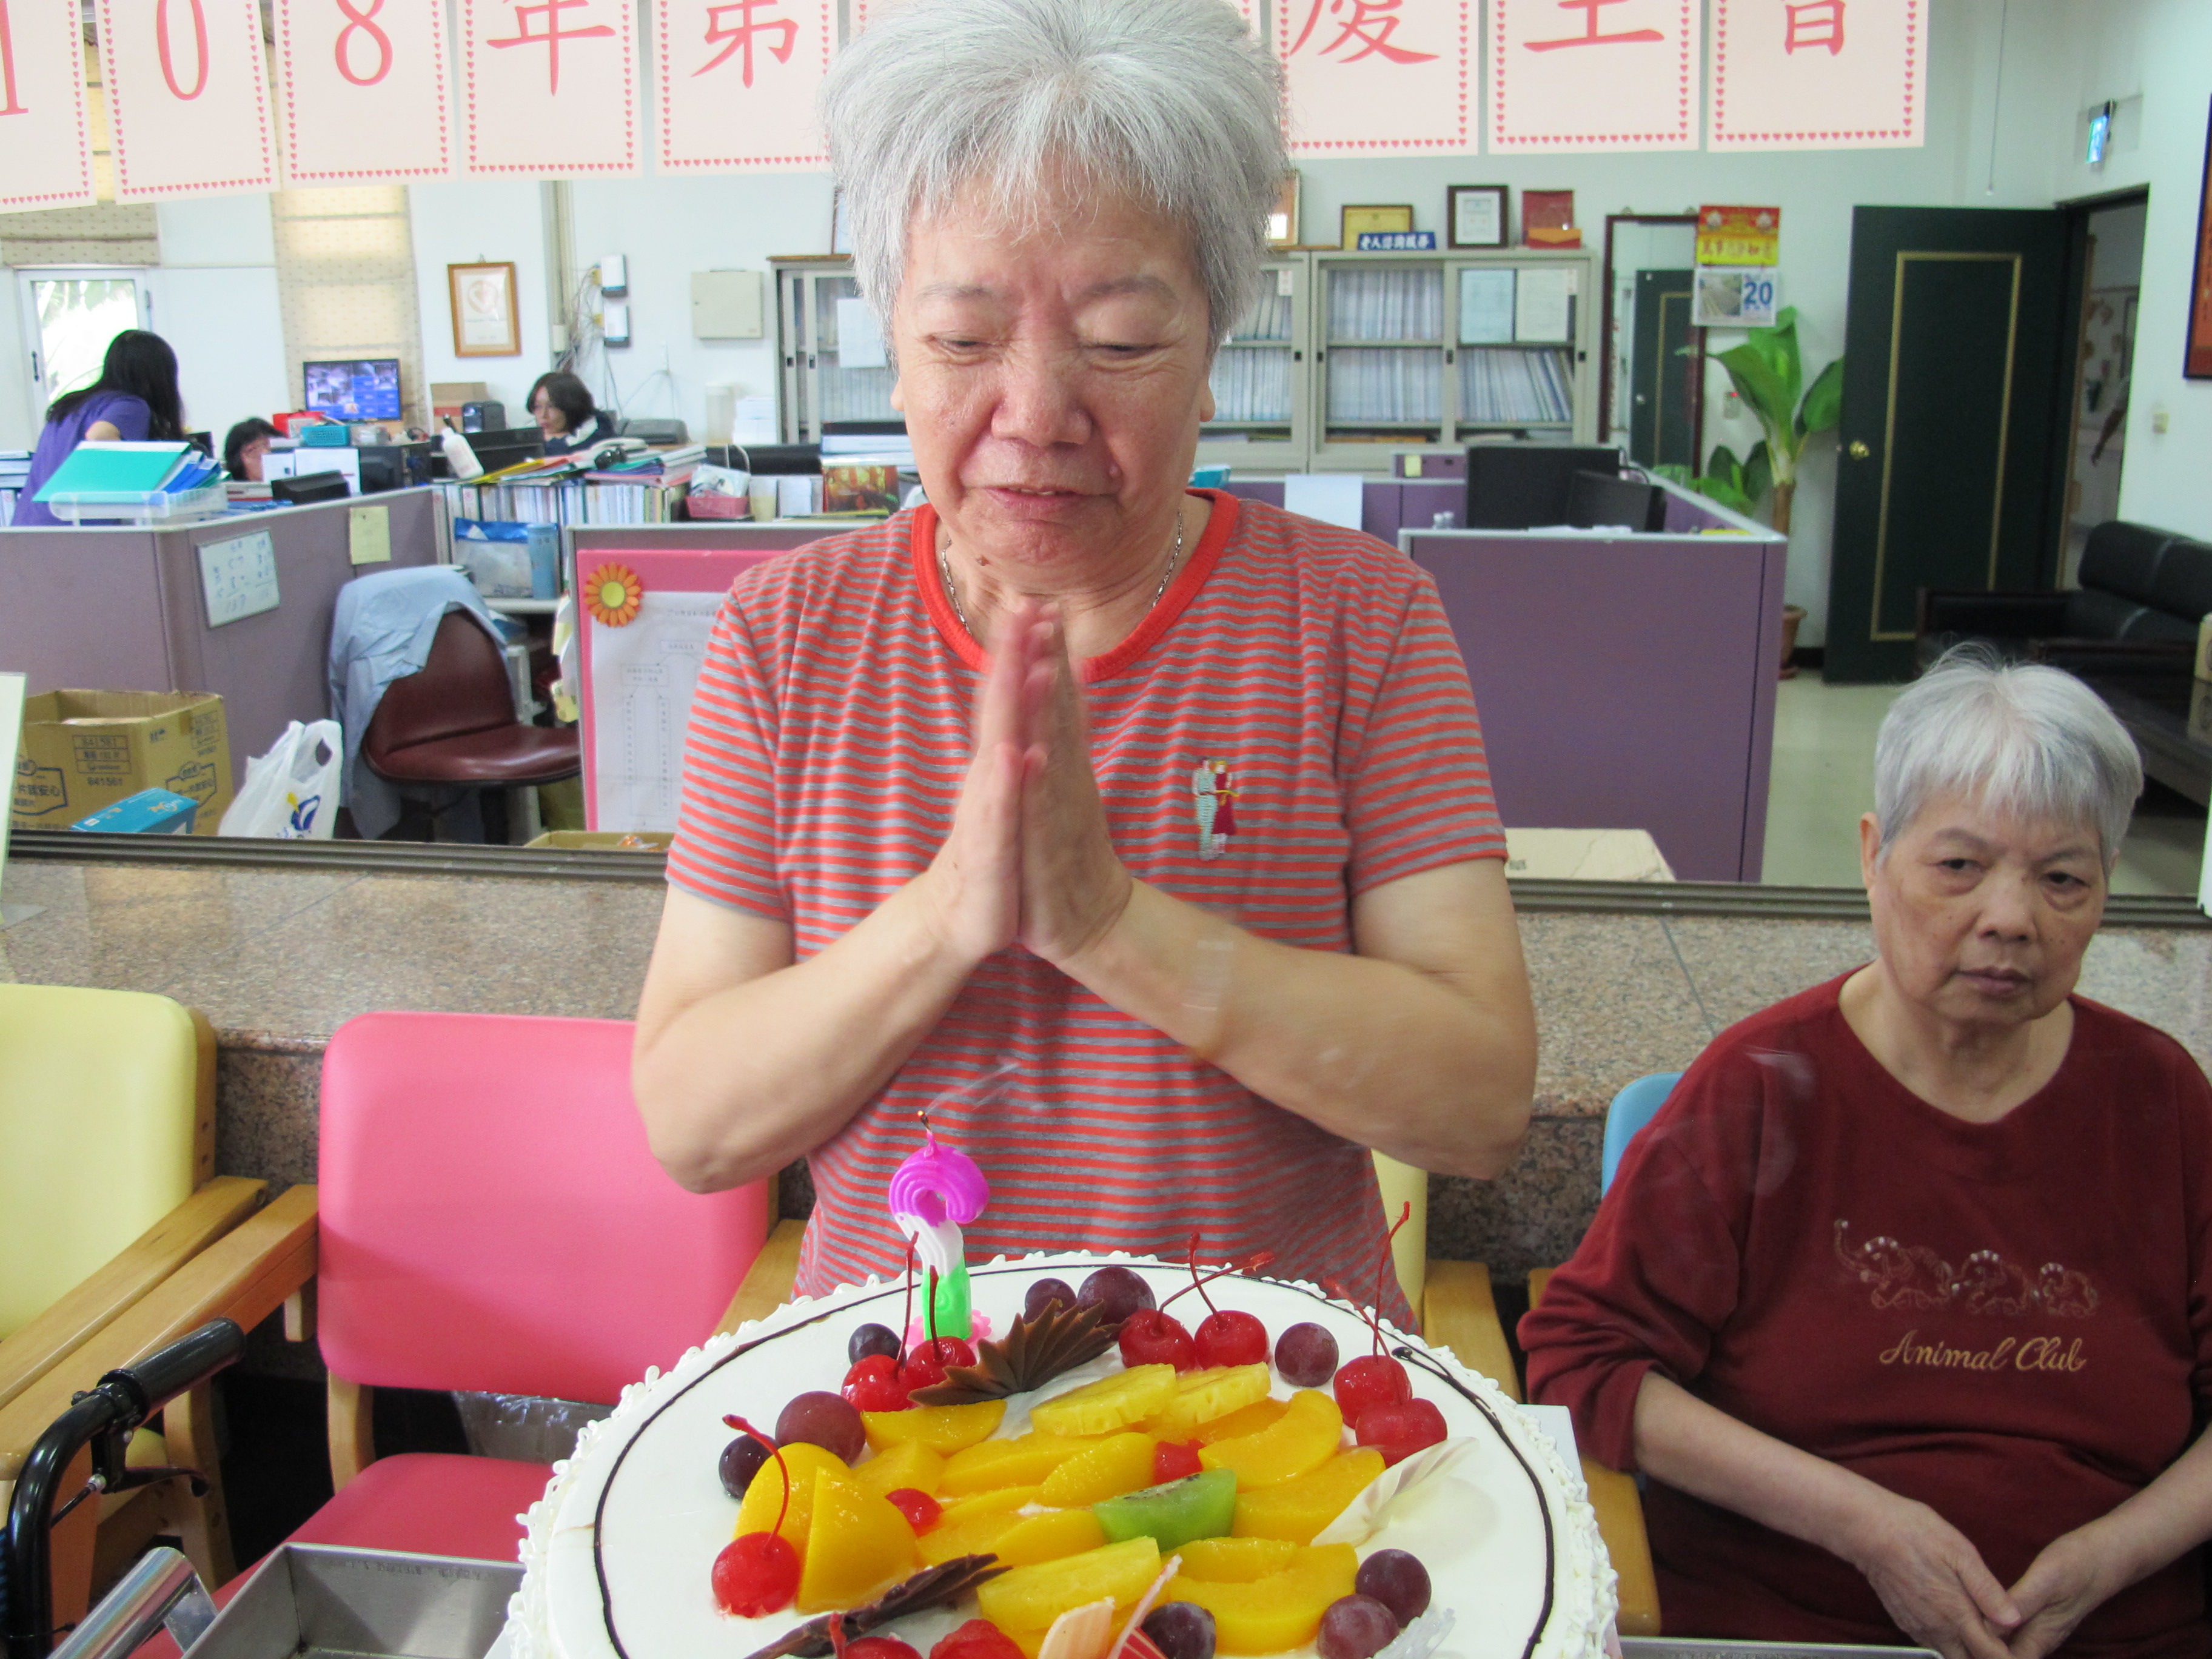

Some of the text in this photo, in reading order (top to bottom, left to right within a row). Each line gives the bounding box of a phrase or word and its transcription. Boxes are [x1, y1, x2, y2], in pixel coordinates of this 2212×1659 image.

[1744, 281, 1774, 305] 20
[1880, 1329, 2087, 1372] Animal Club
